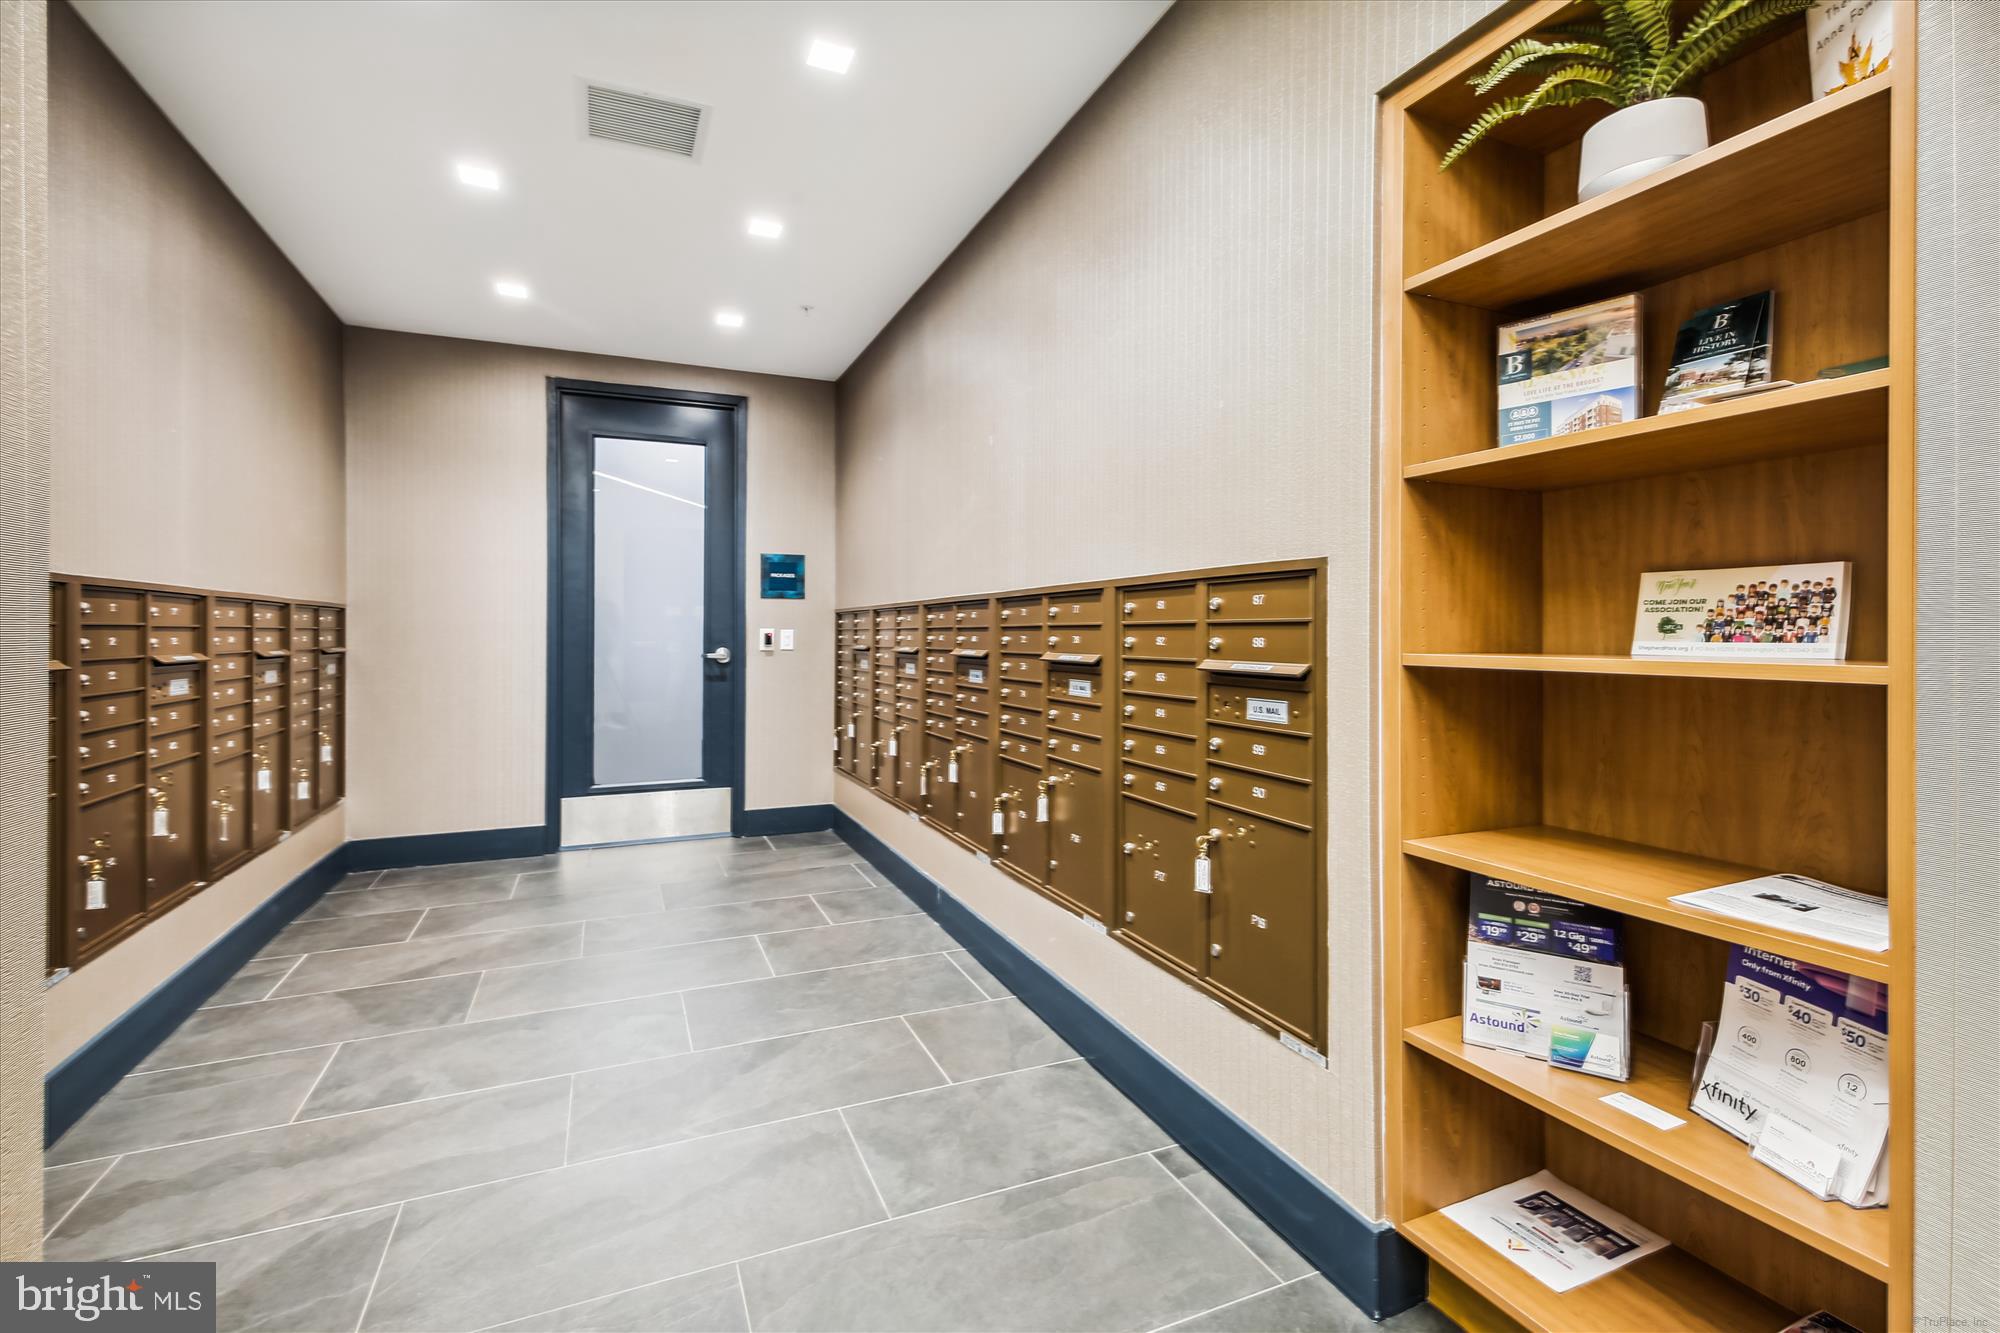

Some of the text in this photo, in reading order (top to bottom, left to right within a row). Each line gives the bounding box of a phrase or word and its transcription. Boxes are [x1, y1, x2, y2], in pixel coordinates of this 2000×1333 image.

[1816, 24, 1844, 51] Anne
[1714, 314, 1729, 328] B
[1692, 338, 1737, 354] HISTORY
[1698, 331, 1735, 346] LIVE IN
[1505, 355, 1524, 375] B
[1539, 386, 1552, 395] LIFE
[1266, 707, 1280, 716] MAIL
[1568, 932, 1586, 943] Gig
[1742, 958, 1760, 972] Only
[1761, 966, 1782, 979] from
[1740, 985, 1760, 1002] $30
[1470, 1012, 1525, 1033] Astound
[1788, 1005, 1811, 1024] $40
[1742, 1033, 1757, 1044] 400
[1841, 1027, 1866, 1047] $50
[1700, 1079, 1758, 1121] xfinity
